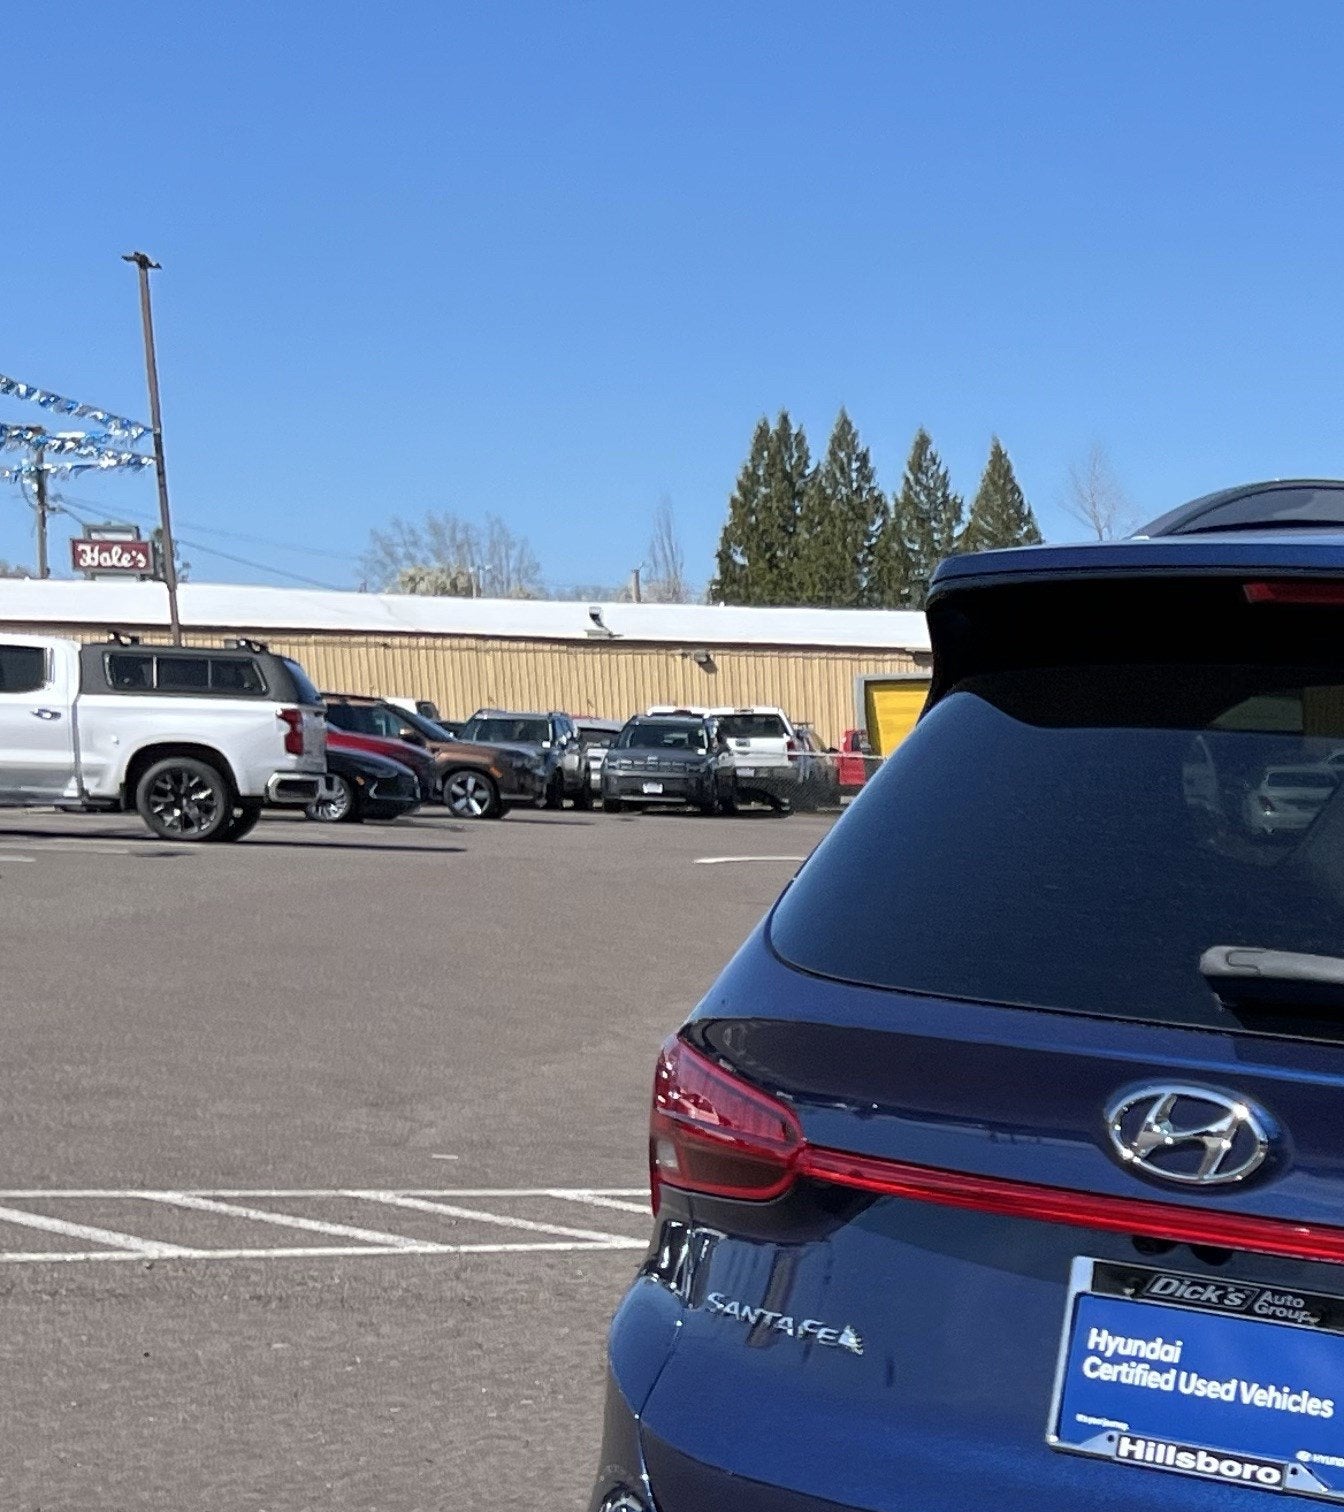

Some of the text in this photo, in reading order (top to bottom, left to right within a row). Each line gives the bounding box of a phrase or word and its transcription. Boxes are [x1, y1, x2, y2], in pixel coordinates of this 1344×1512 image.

[77, 543, 147, 568] Hale's
[1150, 1276, 1305, 1308] Dick's Auto
[707, 1292, 794, 1337] SANTA
[1253, 1301, 1313, 1324] Group
[1087, 1327, 1183, 1364] Hyundai
[1082, 1355, 1335, 1419] Certified Used Vehicles
[1117, 1436, 1282, 1484] Hillsboro
